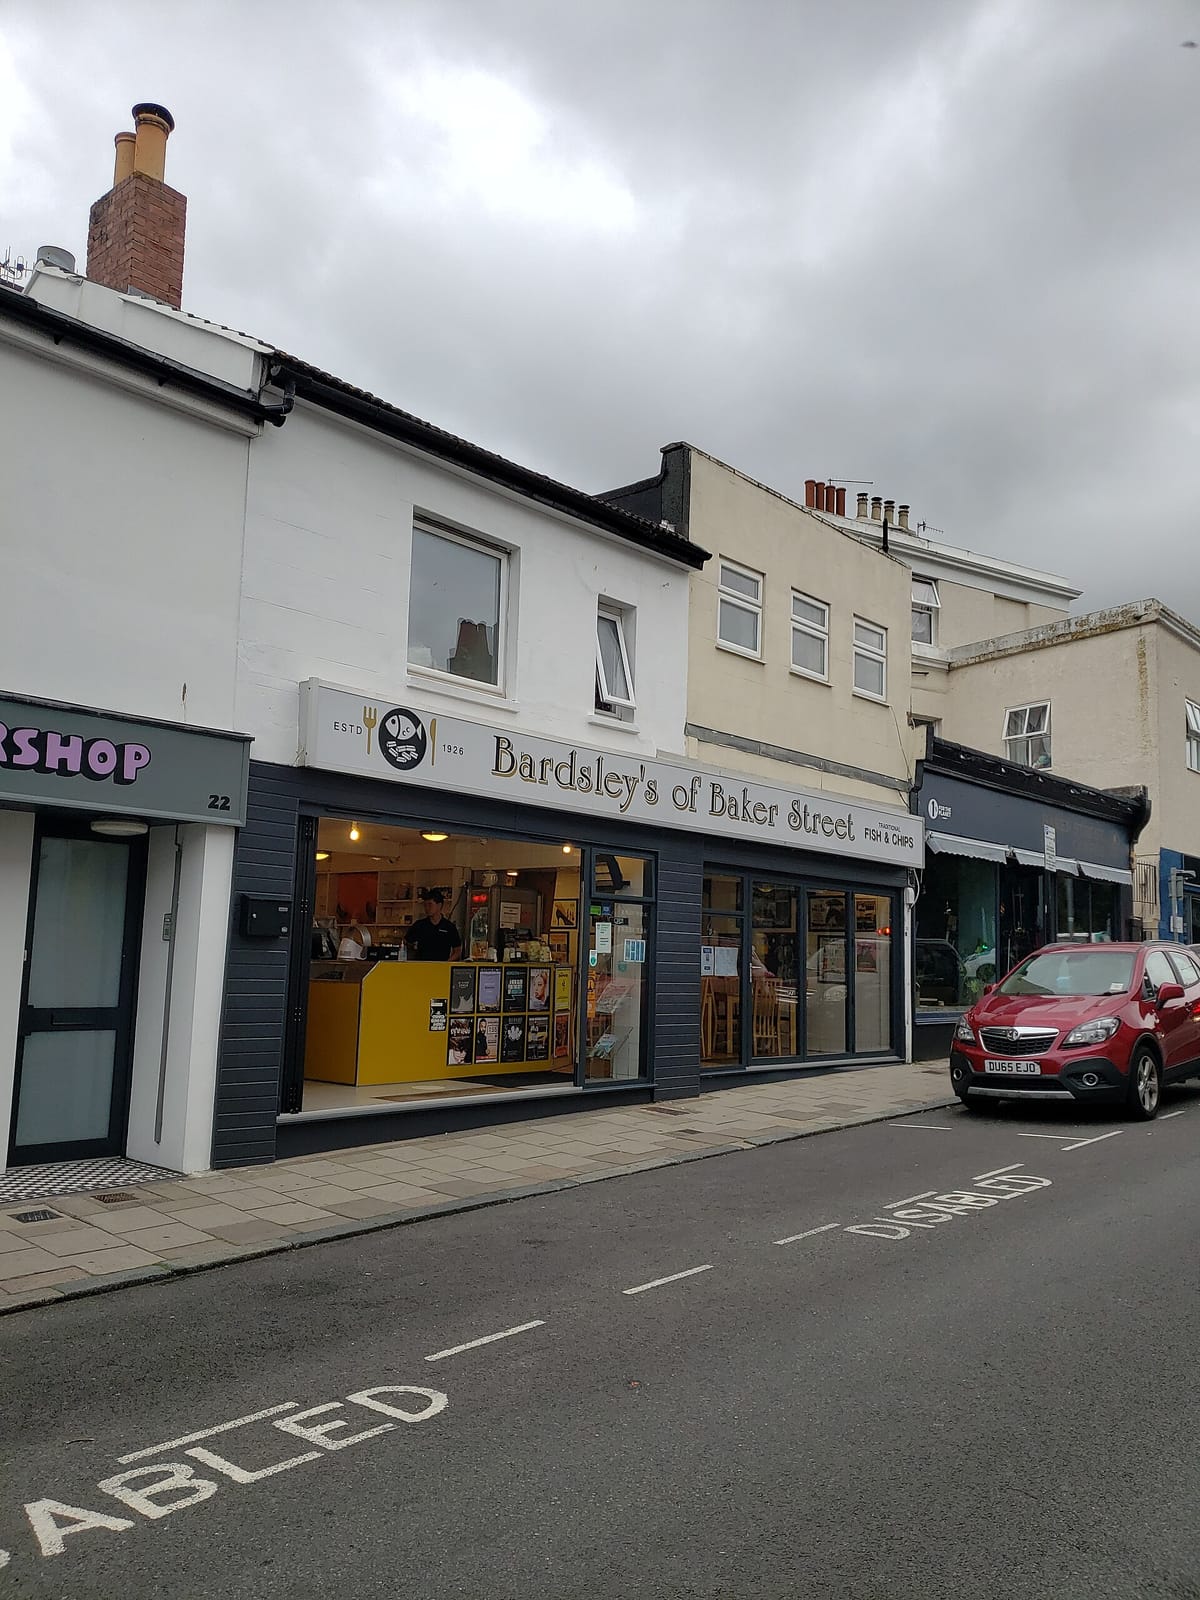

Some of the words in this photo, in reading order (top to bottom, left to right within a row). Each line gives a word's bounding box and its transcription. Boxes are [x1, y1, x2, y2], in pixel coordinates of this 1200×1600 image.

[333, 721, 363, 735] ESTD
[442, 744, 464, 756] 1926
[491, 735, 659, 812] Bardsley's
[672, 776, 702, 812] of
[709, 782, 778, 825] Baker
[787, 800, 855, 842] Street
[207, 794, 231, 811] 22
[864, 827, 882, 843] FISH
[884, 831, 890, 844] &
[891, 833, 914, 849] CHIPS
[988, 1061, 1014, 1072] DU65
[843, 1175, 1053, 1240] DISABLED
[0, 1385, 449, 1568] ABLED
